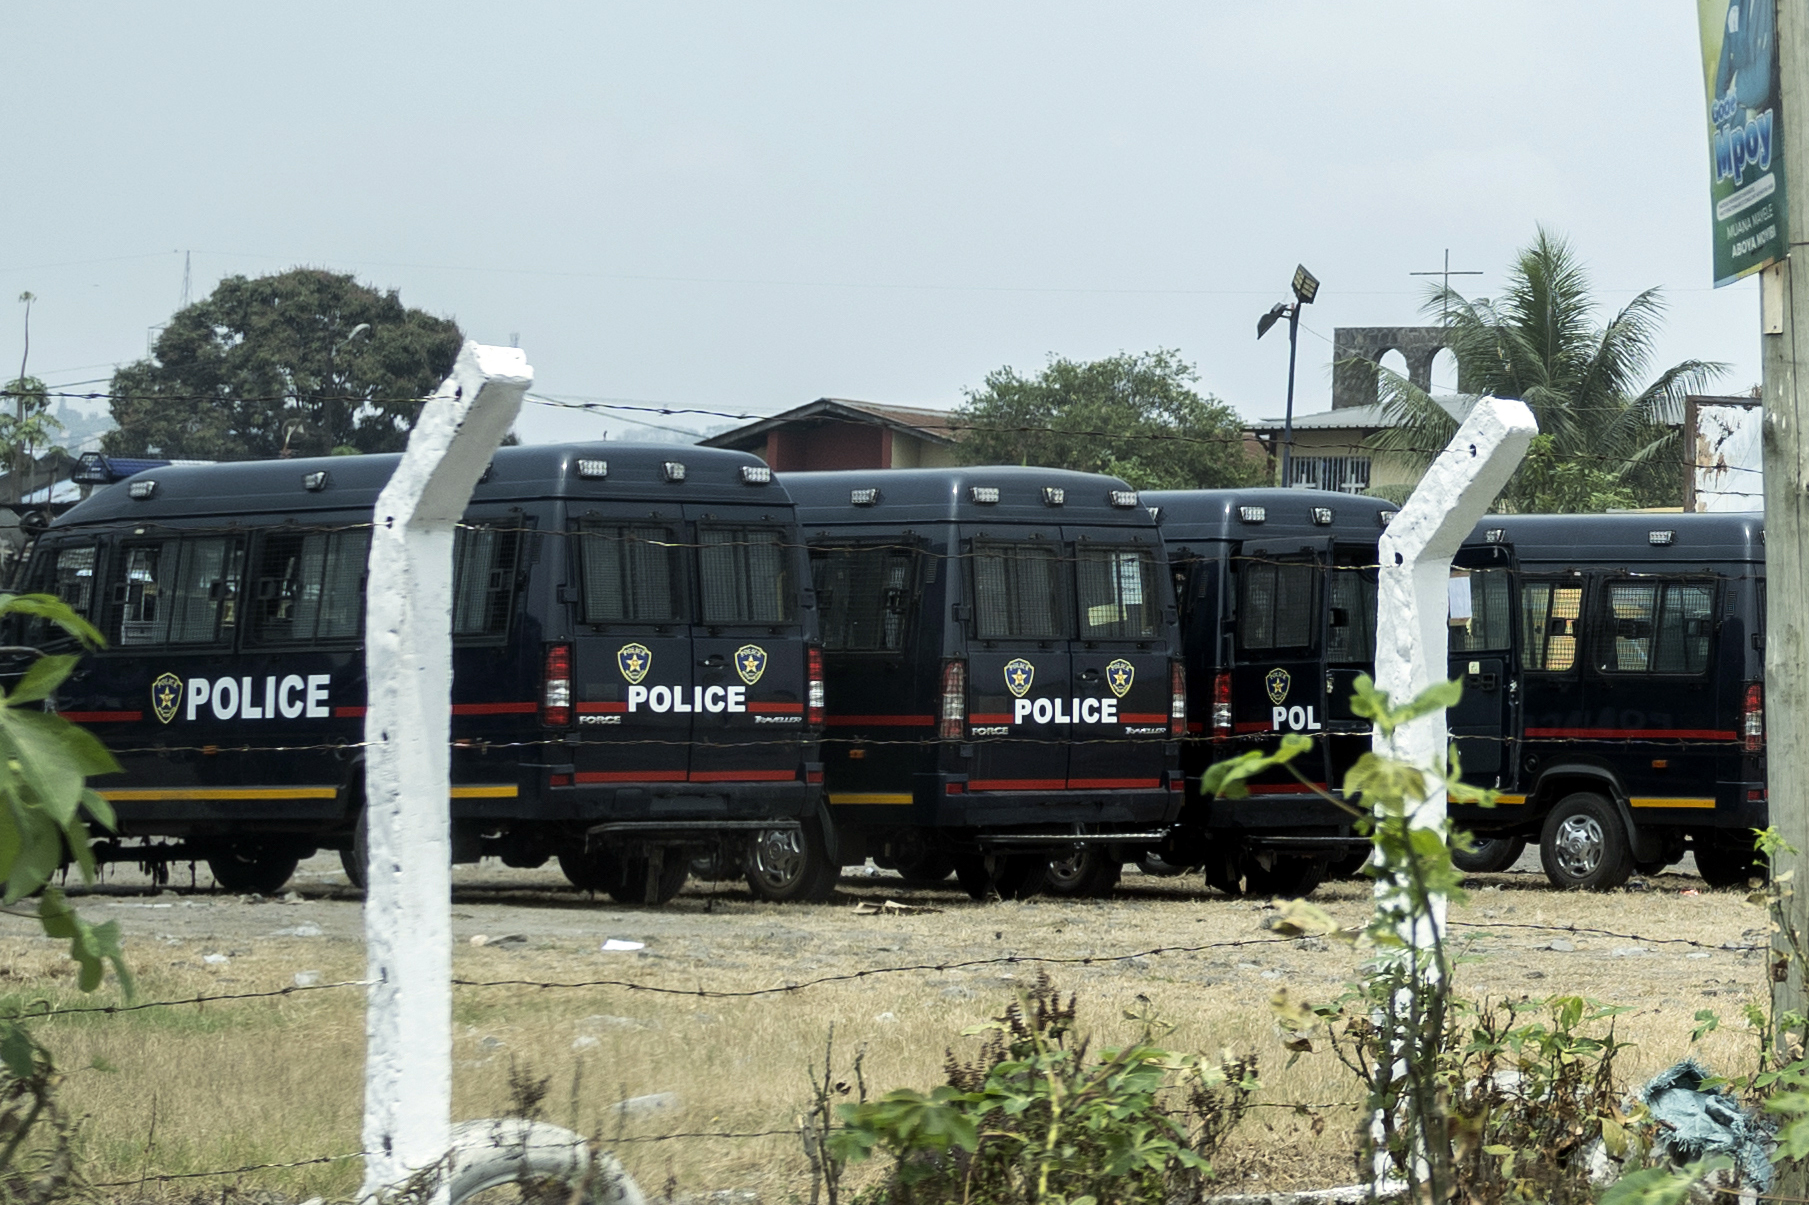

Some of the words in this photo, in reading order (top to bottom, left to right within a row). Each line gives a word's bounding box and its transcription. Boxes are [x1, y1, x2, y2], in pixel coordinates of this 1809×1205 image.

[1713, 108, 1773, 186] Mpoy
[186, 674, 331, 721] POLICE
[628, 685, 746, 713] POLICE
[578, 715, 621, 725] FORCE
[1014, 698, 1118, 724] POLICE
[1272, 705, 1321, 731] POL
[971, 726, 1009, 736] FORCE
